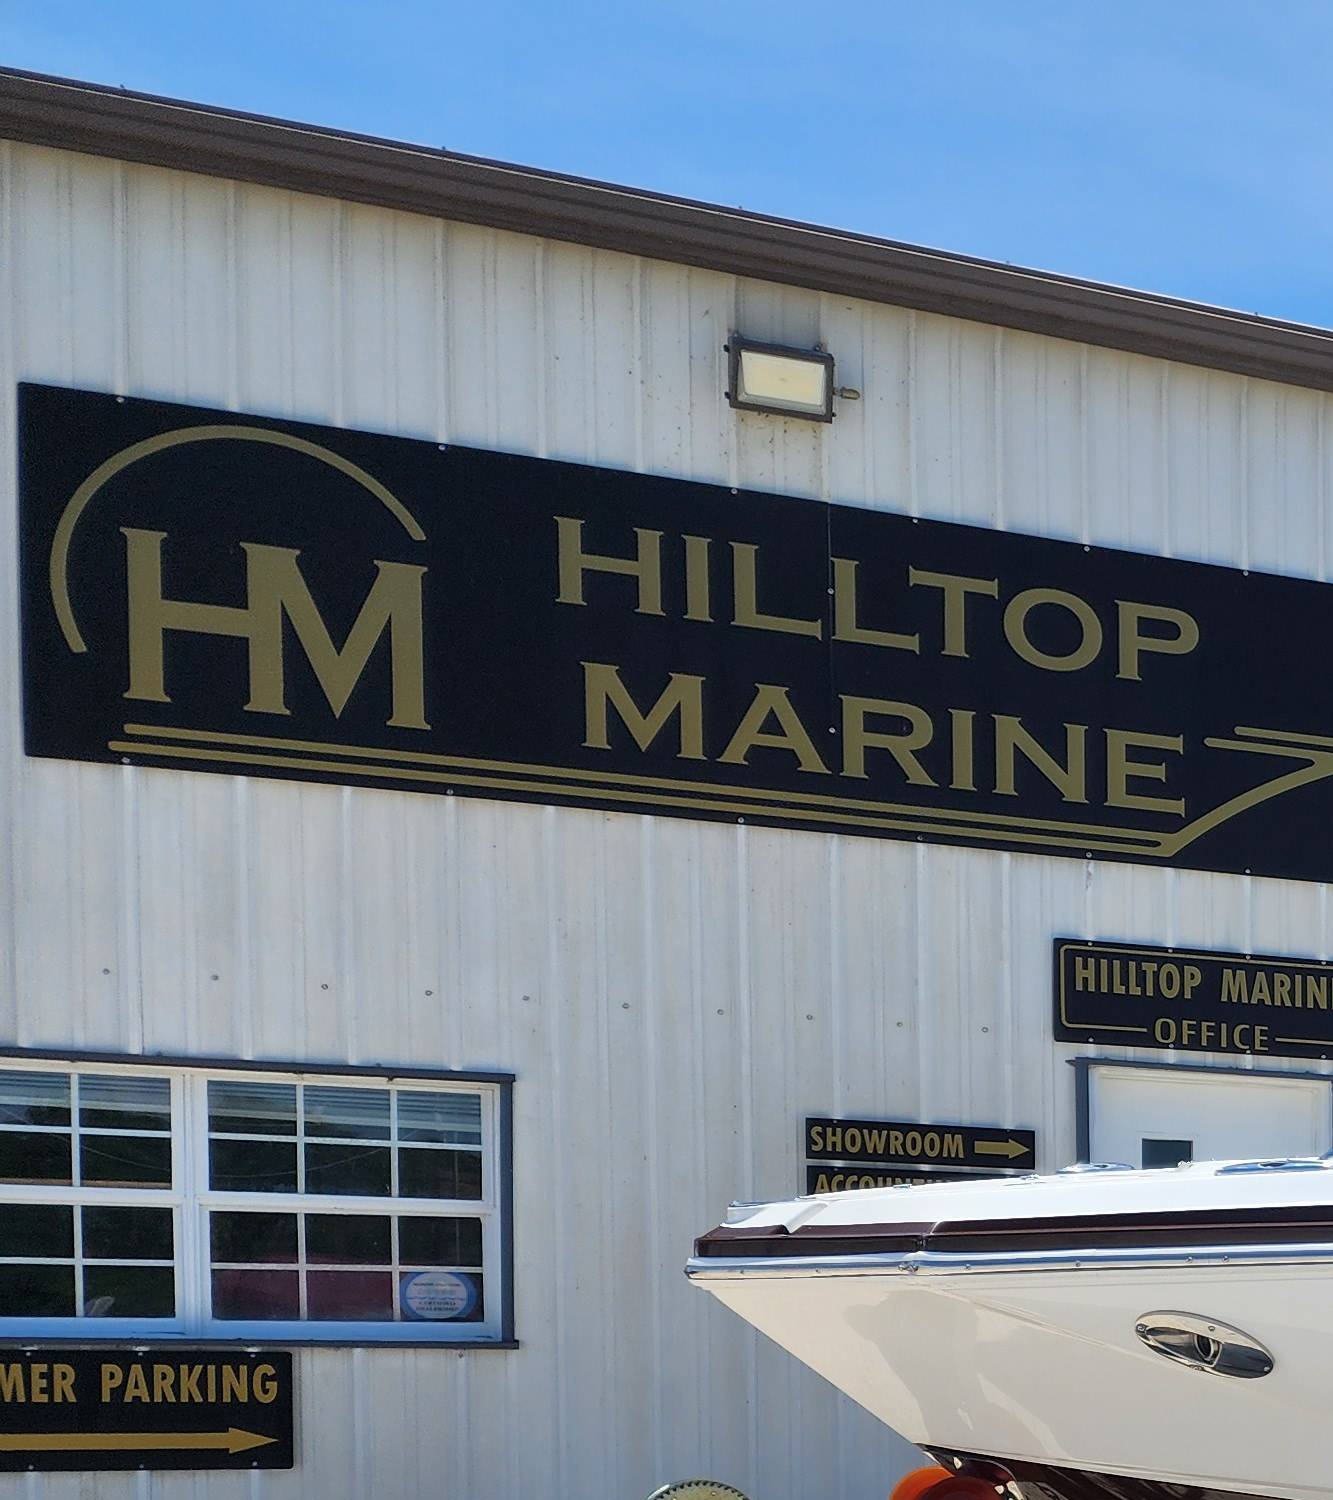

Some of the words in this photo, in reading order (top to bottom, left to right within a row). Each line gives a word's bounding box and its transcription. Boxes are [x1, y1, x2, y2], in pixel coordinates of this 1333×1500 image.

[553, 515, 1201, 681] HILLTOP
[118, 526, 433, 732] HM
[579, 660, 1187, 818] MARINE
[1074, 956, 1202, 999] HILLTOP
[1153, 1017, 1270, 1051] OFFICE
[809, 1125, 965, 1159] SHOWROOM
[101, 1363, 279, 1404] PARKING
